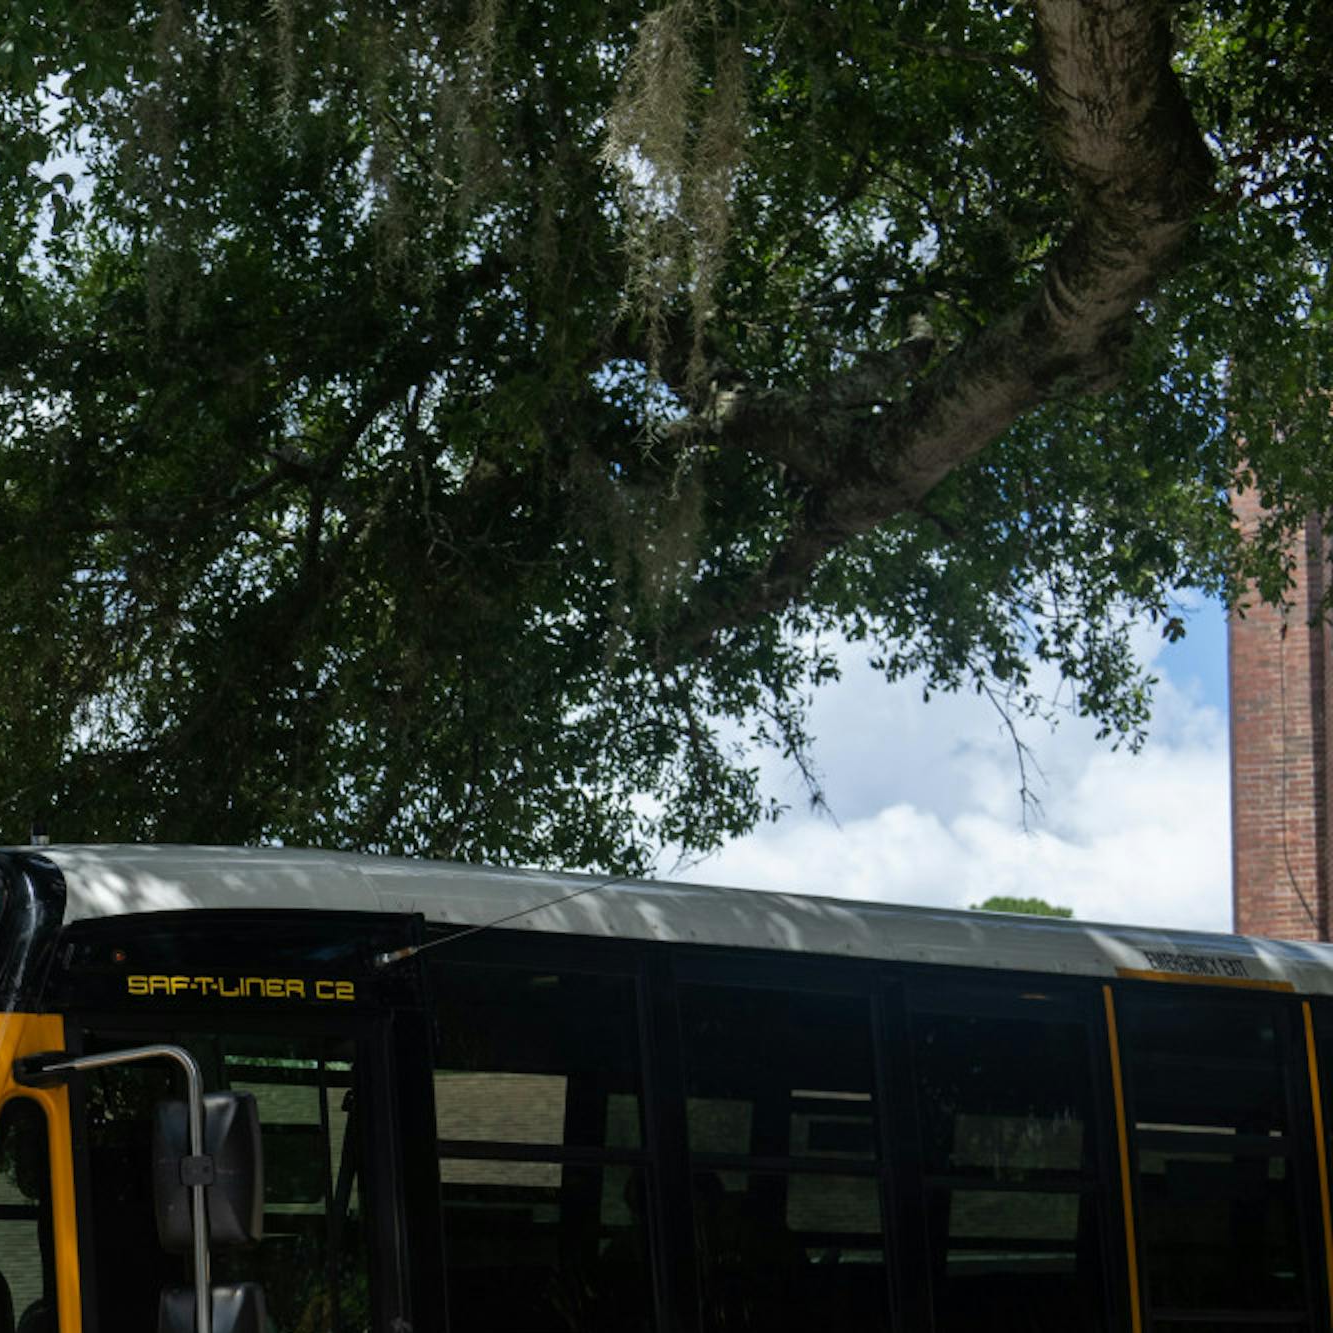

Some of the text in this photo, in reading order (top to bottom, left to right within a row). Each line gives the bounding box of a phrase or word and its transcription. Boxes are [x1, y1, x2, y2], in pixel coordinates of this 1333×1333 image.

[1144, 951, 1249, 977] EMERGENCY EXIT
[127, 975, 355, 1000] SAF-T-LINER C2
